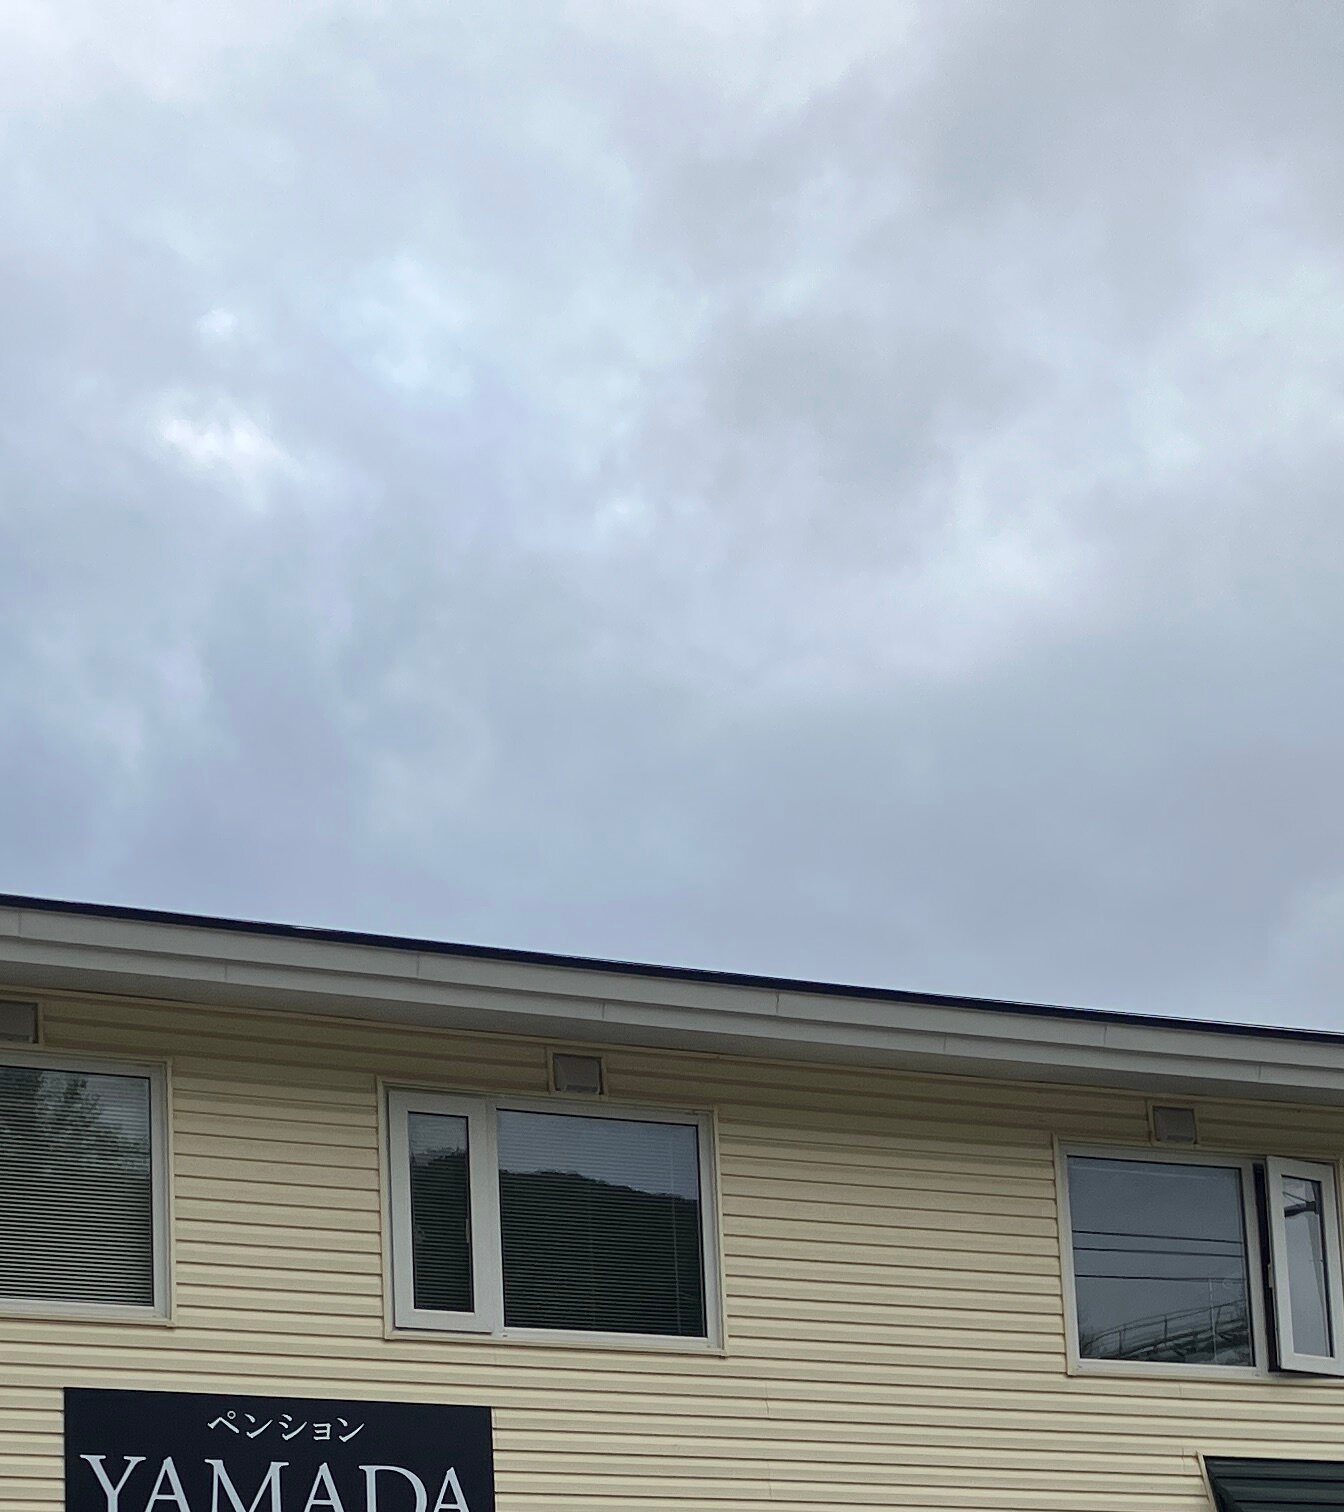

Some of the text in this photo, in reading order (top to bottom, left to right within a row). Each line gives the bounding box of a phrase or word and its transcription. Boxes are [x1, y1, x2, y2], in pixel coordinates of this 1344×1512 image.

[208, 1411, 365, 1442] ペンション
